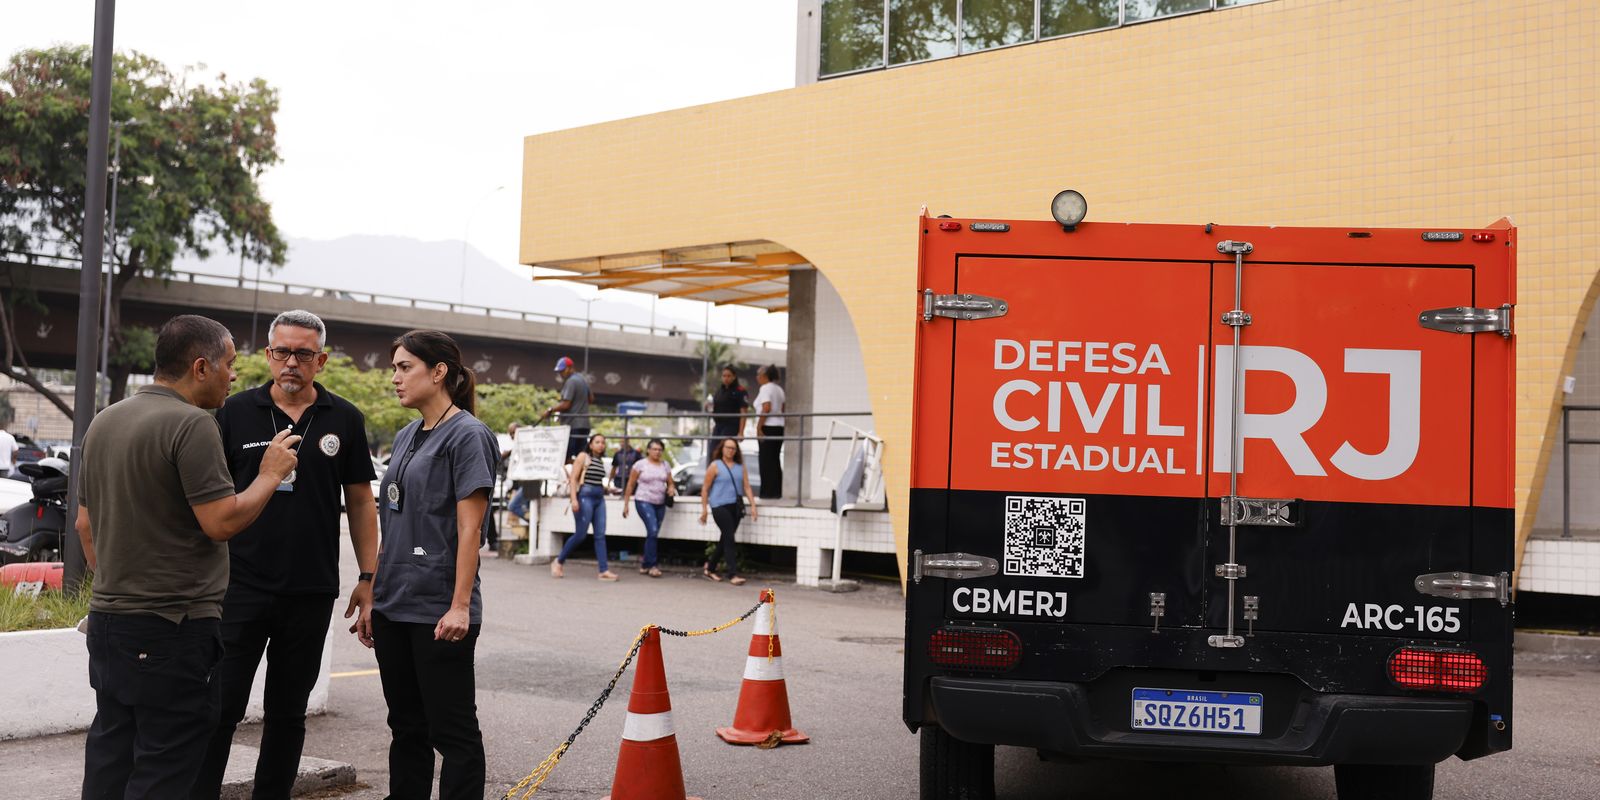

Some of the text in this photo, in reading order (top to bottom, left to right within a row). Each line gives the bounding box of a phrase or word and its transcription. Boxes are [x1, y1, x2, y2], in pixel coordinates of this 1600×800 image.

[994, 339, 1171, 375] DEFESA
[993, 379, 1185, 437] CIVIL
[1213, 344, 1421, 481] RJ
[991, 442, 1186, 475] ESTADUAL
[952, 587, 1067, 617] CBMERJ
[1340, 602, 1461, 633] ARC-165
[1134, 719, 1142, 727] BR
[1144, 703, 1245, 730] SQZ6H51
